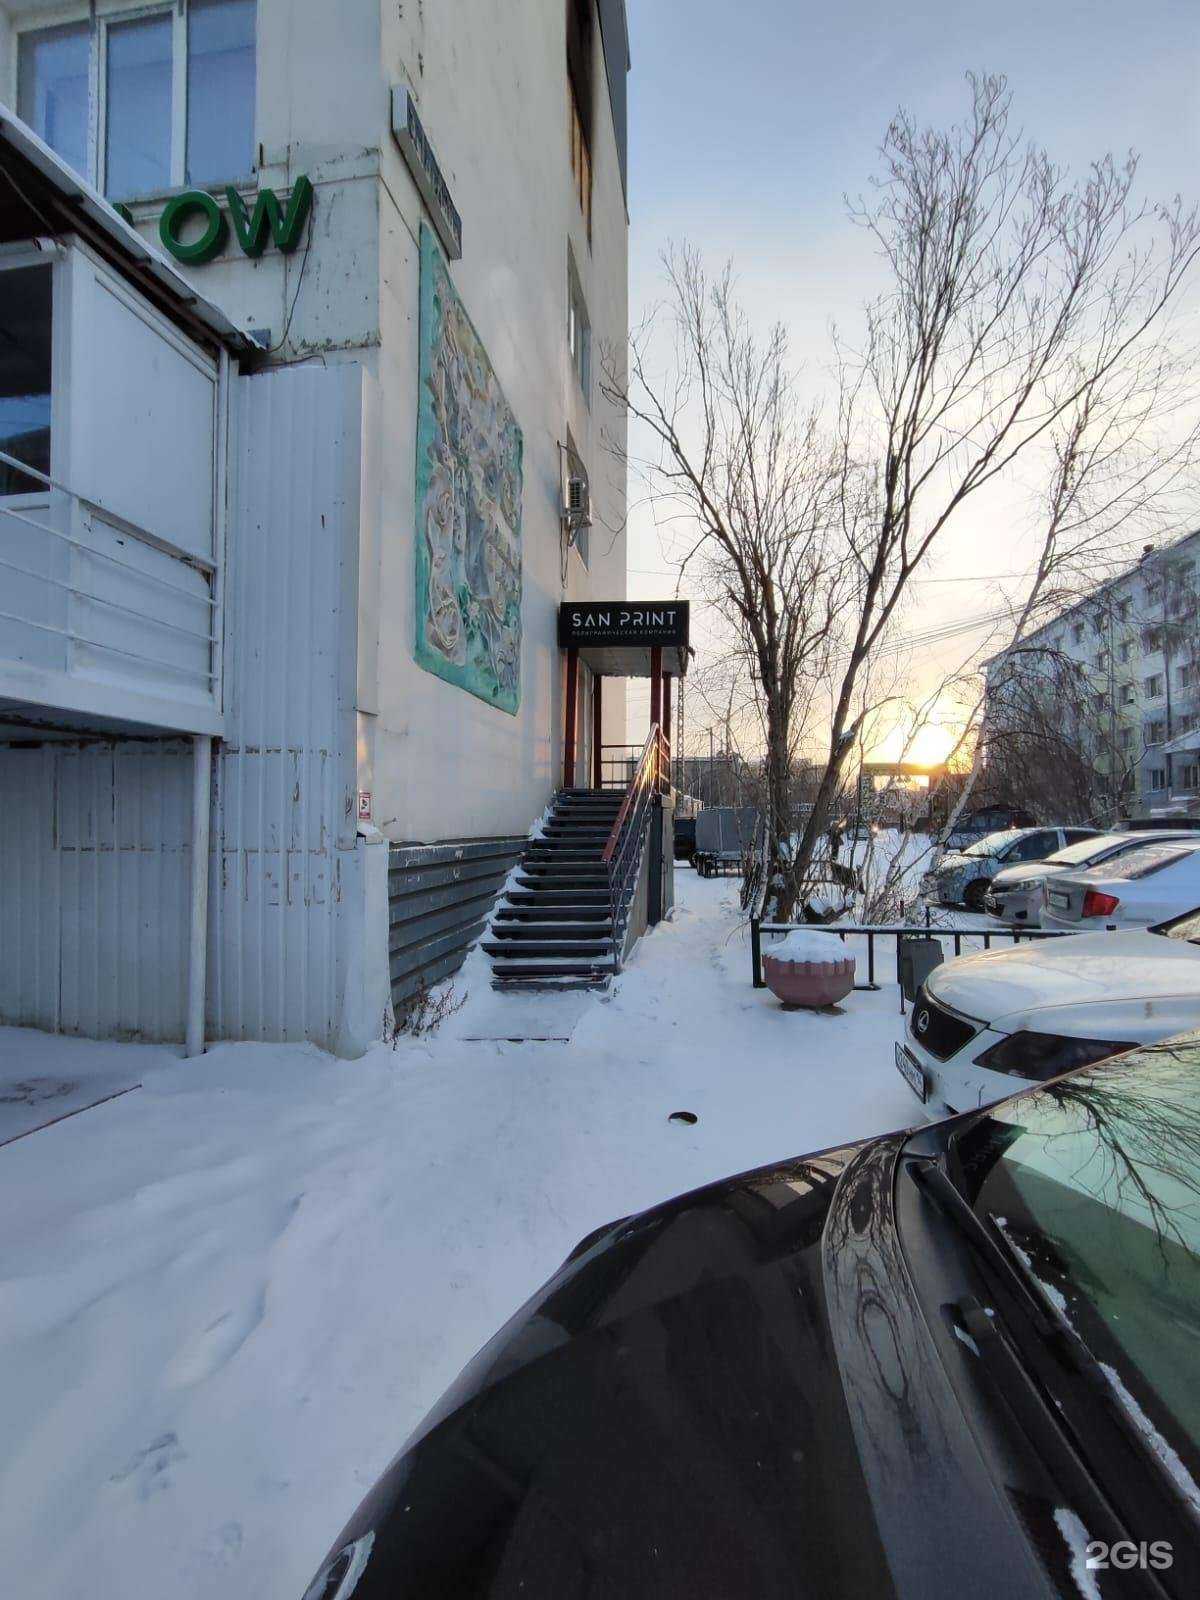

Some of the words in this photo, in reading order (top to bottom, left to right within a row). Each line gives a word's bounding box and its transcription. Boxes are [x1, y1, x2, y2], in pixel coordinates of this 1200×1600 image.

[113, 175, 313, 266] OW
[572, 612, 611, 627] SAN
[620, 611, 676, 626] PRINT
